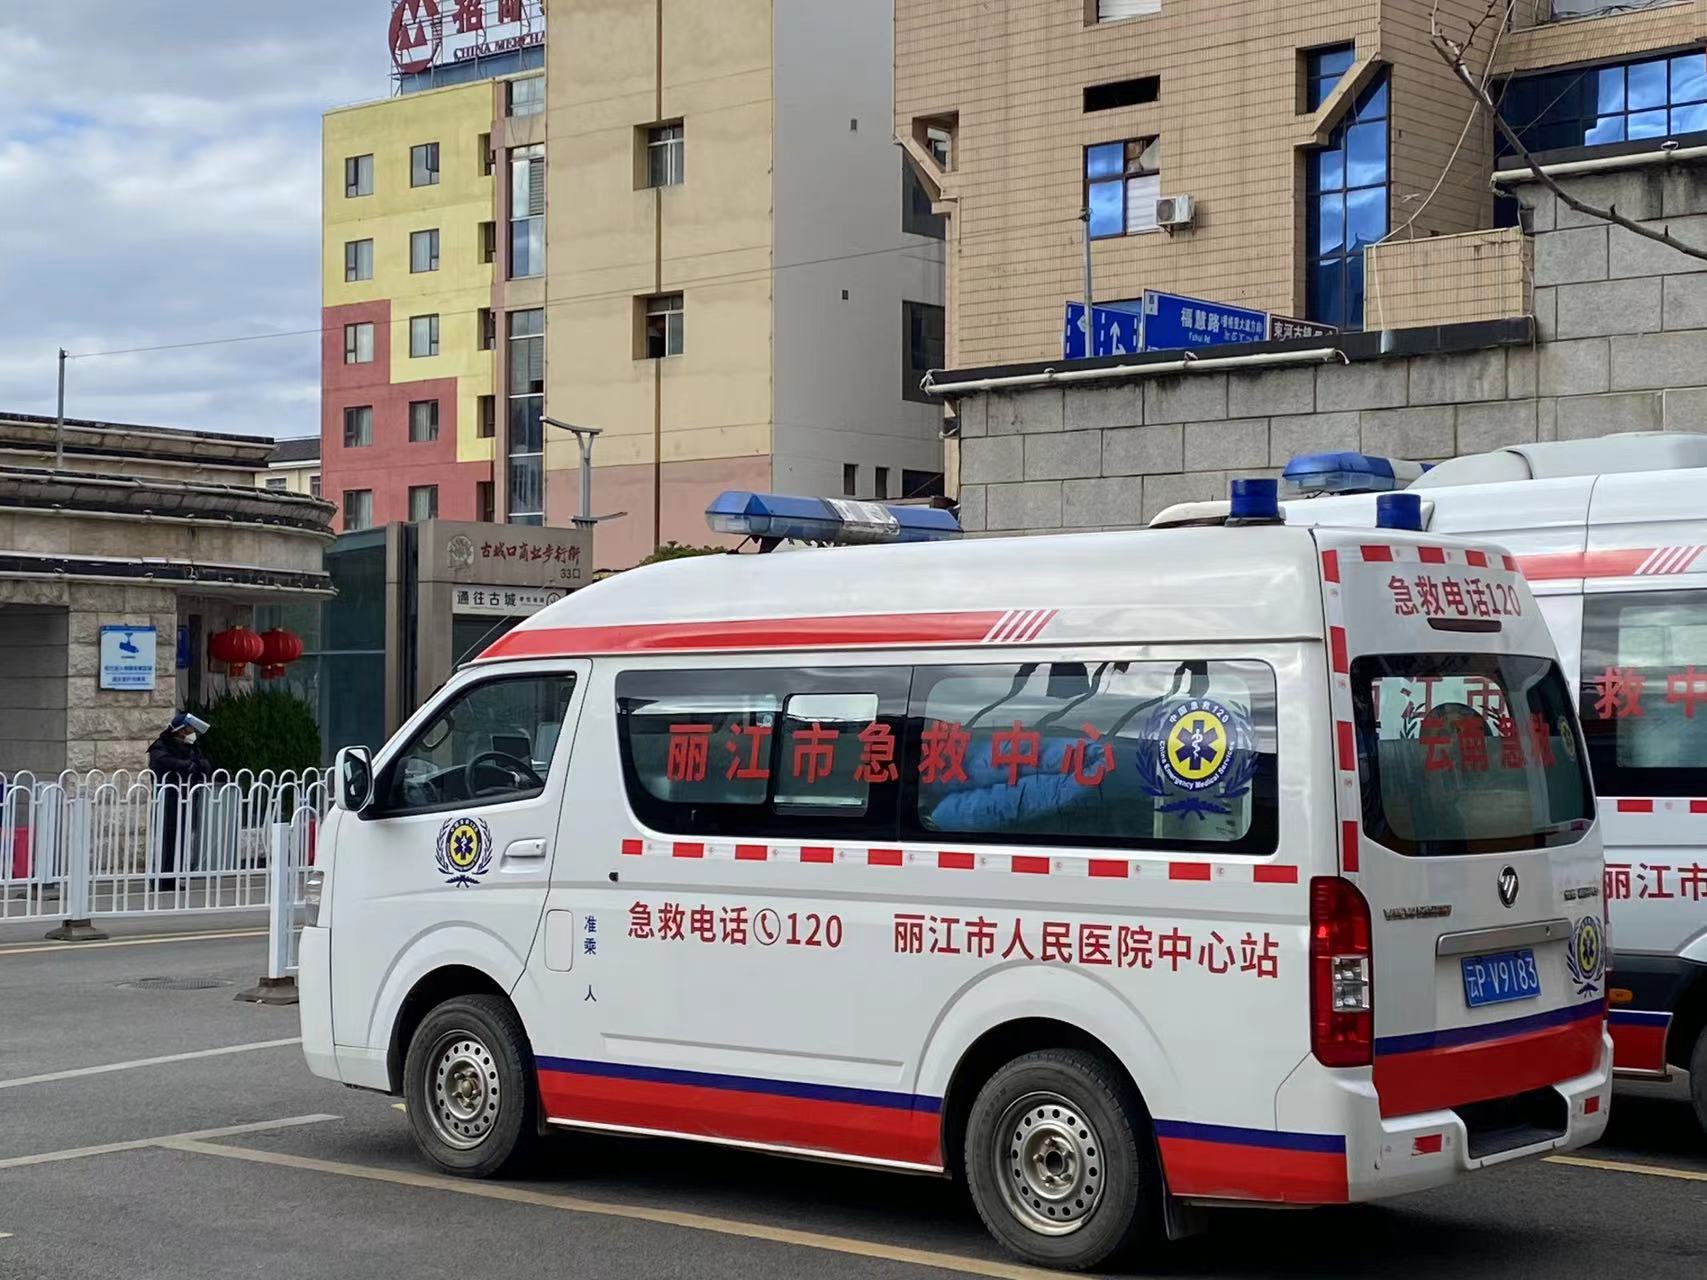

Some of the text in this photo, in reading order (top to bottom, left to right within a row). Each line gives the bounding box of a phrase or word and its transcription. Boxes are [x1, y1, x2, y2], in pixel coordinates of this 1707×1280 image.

[456, 590, 517, 607] 通往古城
[1388, 575, 1522, 617] 急救电话120
[1169, 700, 1230, 723] 中国急救120
[667, 719, 1116, 787] 丽江市急救中心
[628, 901, 843, 948] 急救电话 120
[894, 913, 1280, 978] 丽江市人民医院中心站
[583, 915, 597, 1002] 准乘 人
